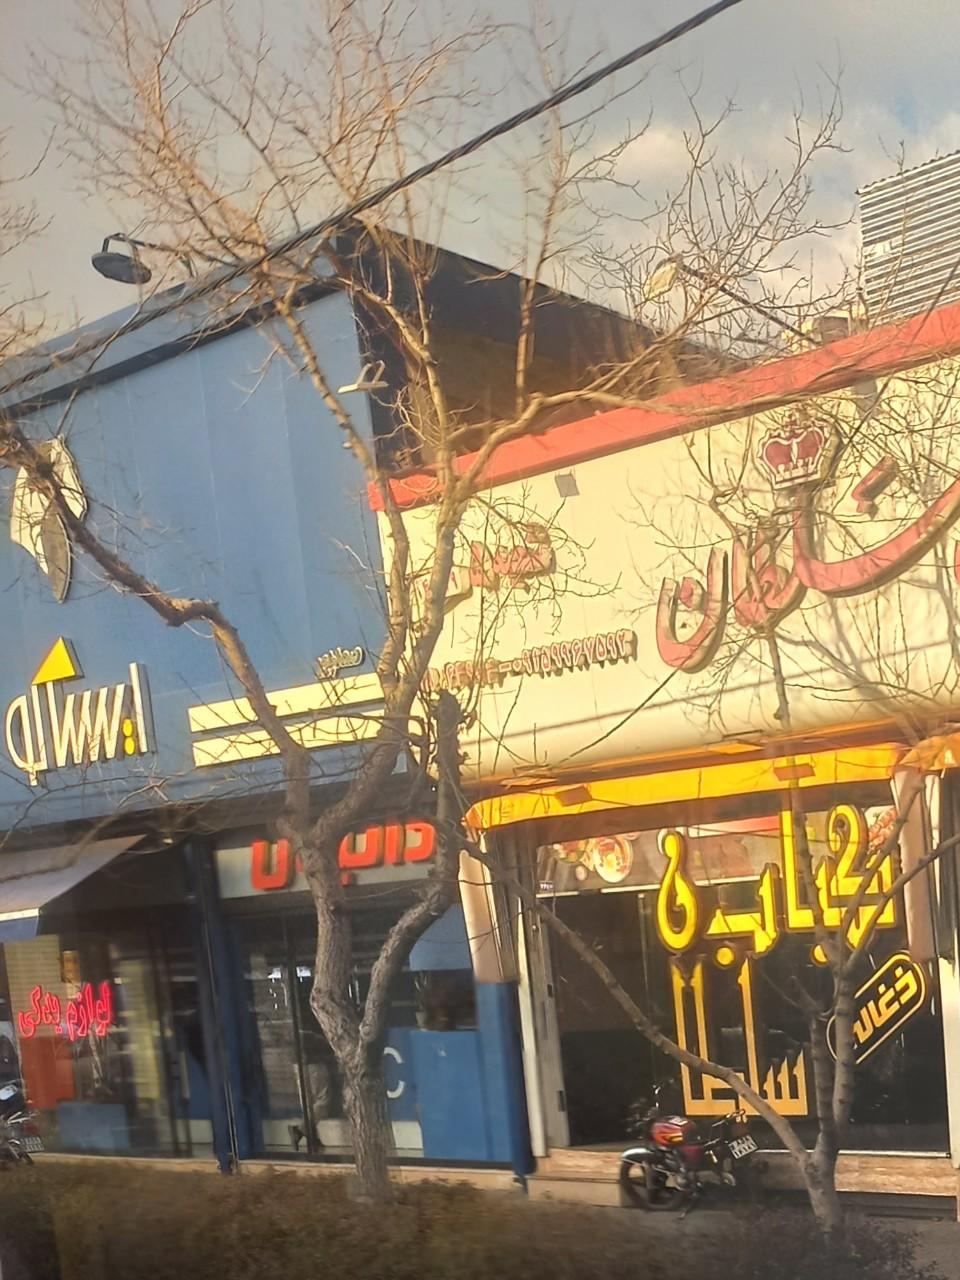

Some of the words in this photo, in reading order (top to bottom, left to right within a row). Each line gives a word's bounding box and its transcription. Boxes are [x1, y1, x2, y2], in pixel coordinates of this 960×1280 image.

[18, 985, 63, 1039] یدکی
[66, 981, 112, 1042] لوازم
[852, 966, 918, 1045] ذغال
